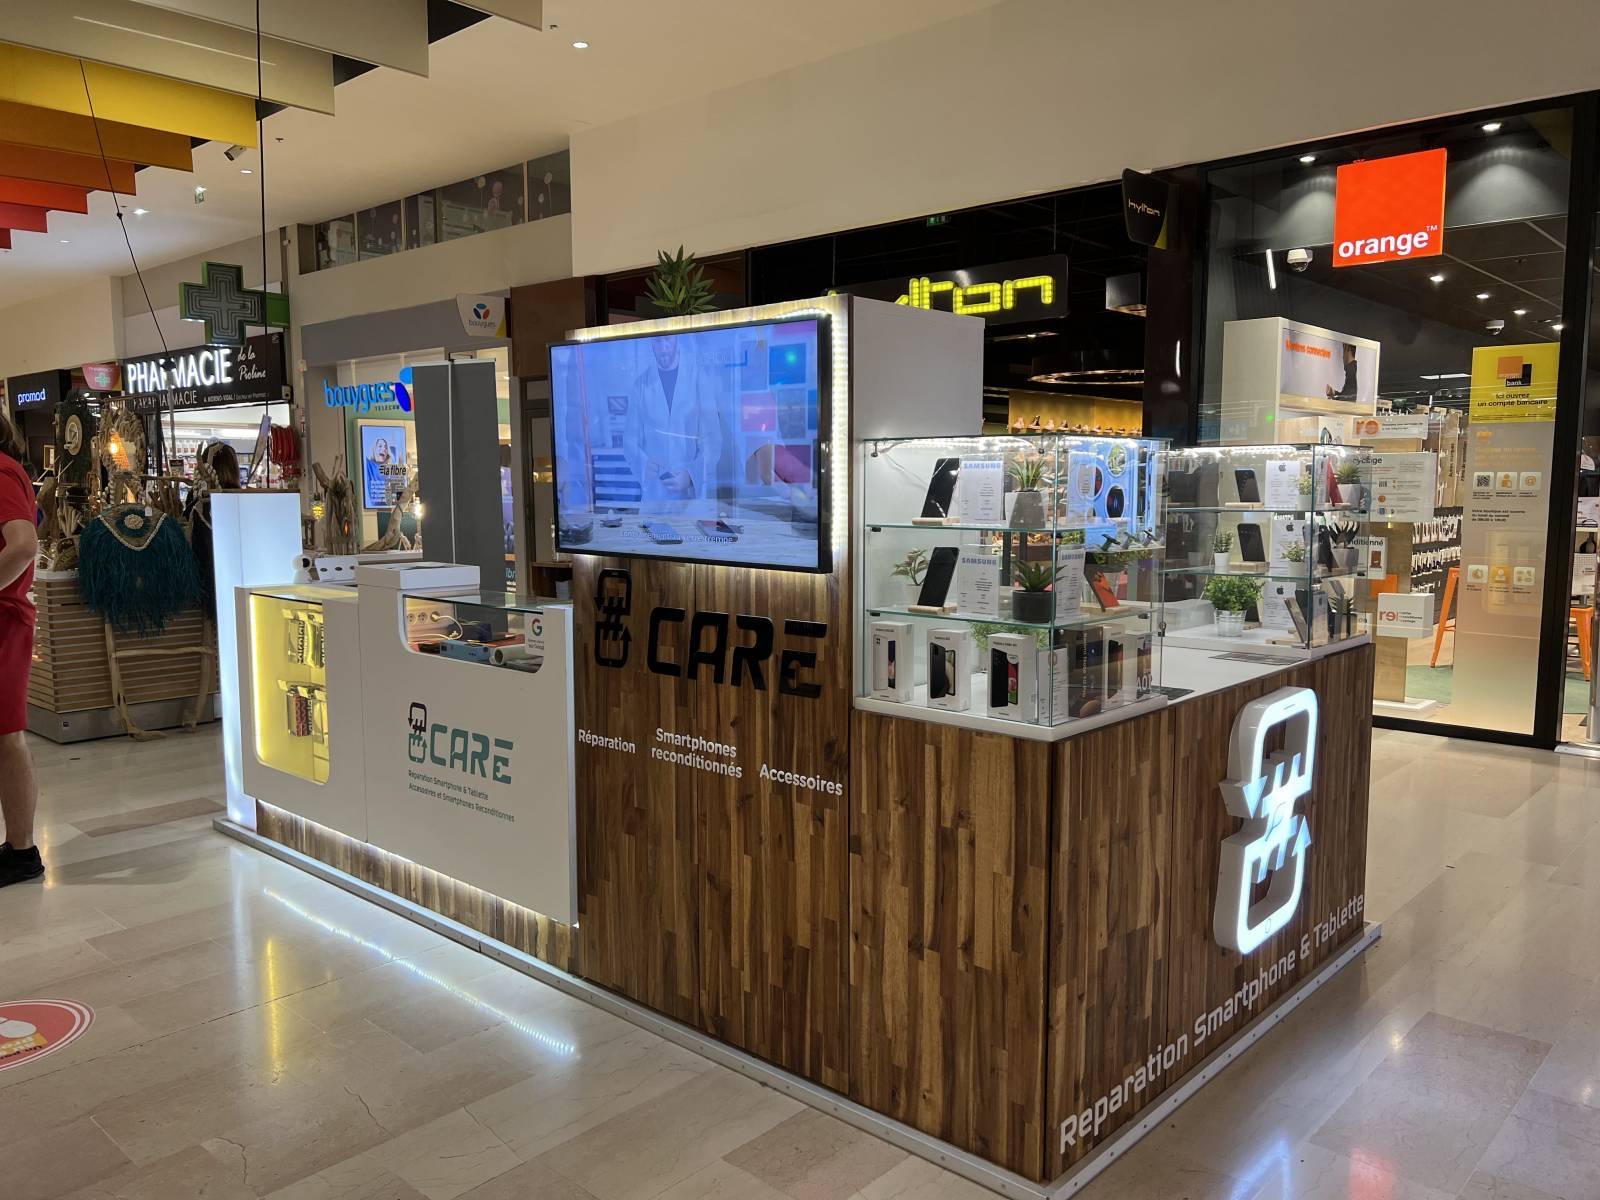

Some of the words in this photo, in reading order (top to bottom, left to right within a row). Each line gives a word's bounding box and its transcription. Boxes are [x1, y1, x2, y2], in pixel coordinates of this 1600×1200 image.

[1128, 198, 1160, 216] hylton
[1338, 231, 1429, 258] orange
[895, 276, 1055, 316] lton
[18, 388, 46, 405] promod
[323, 378, 396, 413] bouygues
[1488, 400, 1514, 408] compte
[391, 465, 407, 475] fibre
[647, 606, 828, 699] CARE
[430, 723, 514, 785] CARE
[578, 729, 636, 754] Réparation
[656, 727, 737, 758] Smartphones
[651, 747, 742, 778] reconditionnés
[759, 763, 843, 796] Accessoires
[409, 782, 436, 797] Accessoires
[443, 793, 475, 810] Smartphones
[1060, 1033, 1187, 1154] Reparation
[1194, 950, 1295, 1046] Smartphone
[1300, 934, 1310, 960] &
[1314, 893, 1364, 949] Tablette
